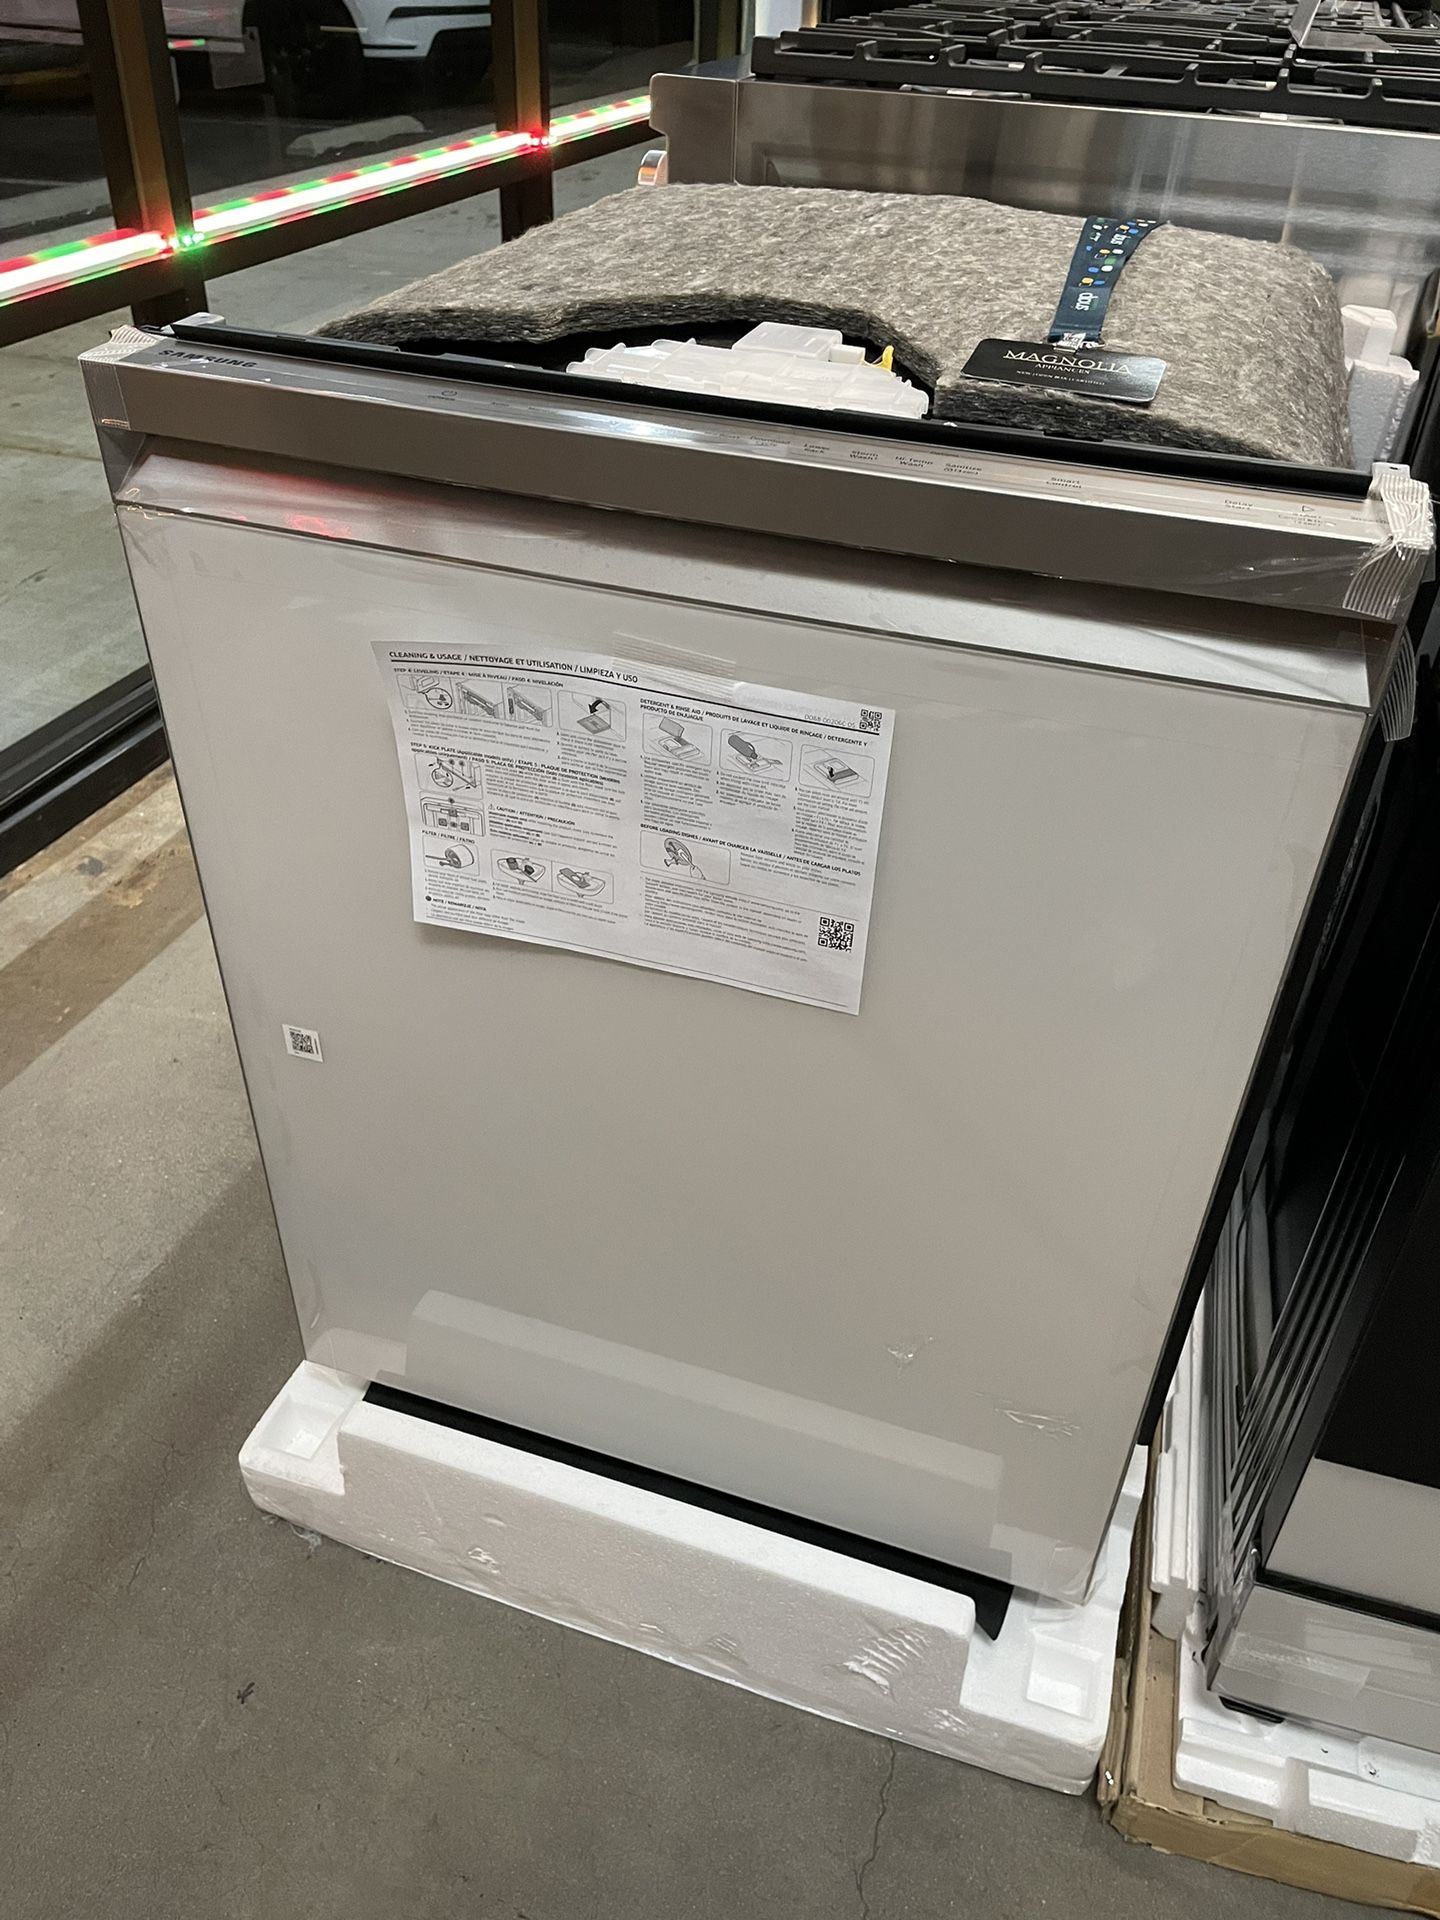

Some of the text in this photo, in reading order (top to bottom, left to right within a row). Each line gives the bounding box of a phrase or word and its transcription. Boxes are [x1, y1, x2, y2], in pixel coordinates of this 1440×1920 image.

[159, 349, 258, 369] SAMSUNG
[1003, 350, 1134, 376] MAGNOLIA
[1224, 499, 1254, 507] Delay
[389, 651, 428, 659] CLEANING
[469, 655, 514, 665] NETTOYAGE
[526, 659, 573, 671] UTILISATION
[580, 666, 614, 679] LIMPIEZA
[622, 674, 638, 683] USO
[640, 704, 667, 714] PRODUCTO
[677, 711, 703, 721] ENJUAGUE
[640, 698, 670, 709] DETERGENT
[706, 711, 731, 720] PRODUITS
[740, 718, 760, 727] LAVAGE
[769, 723, 790, 733] LIQUIDE
[827, 734, 862, 746] DETERGENTE
[541, 764, 560, 772] PLAQUE
[569, 768, 598, 779] PROTECTION
[496, 806, 515, 814] CAUTION
[640, 823, 659, 831] BEFORE
[660, 827, 681, 836] LOADING
[681, 831, 698, 840] DISHES
[702, 837, 719, 845] AVANT
[726, 842, 749, 851] CHARGER
[757, 848, 782, 859] VAISSELLE
[786, 855, 802, 863] ANTES
[810, 860, 831, 870] CARGAR
[842, 868, 861, 876] PLATOS
